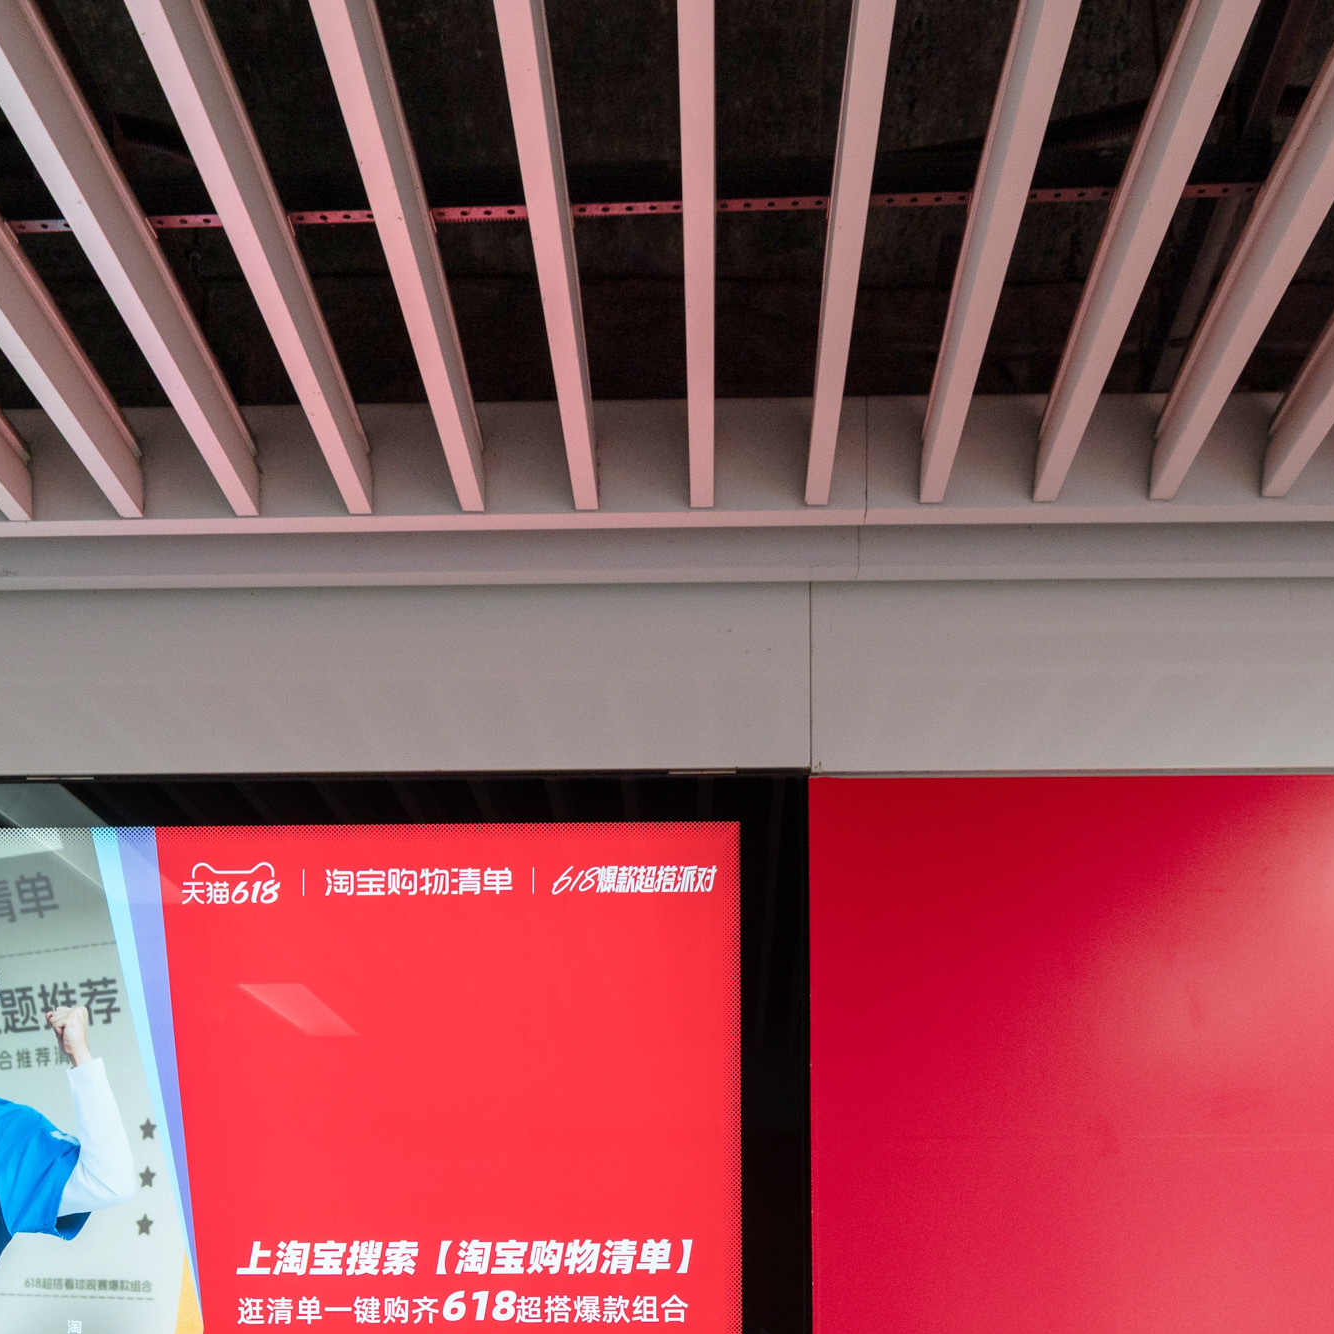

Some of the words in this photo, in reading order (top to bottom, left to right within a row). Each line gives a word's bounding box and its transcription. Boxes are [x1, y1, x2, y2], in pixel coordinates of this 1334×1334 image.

[182, 880, 280, 904] 天猫618
[325, 867, 512, 896] 淘宝购物清单
[552, 866, 717, 895] 618爆款超搭派对
[236, 1239, 692, 1275] 上淘宝搜索【淘宝购物清单】
[238, 1290, 688, 1324] 逛清单一键购齐618超搭爆款组合
